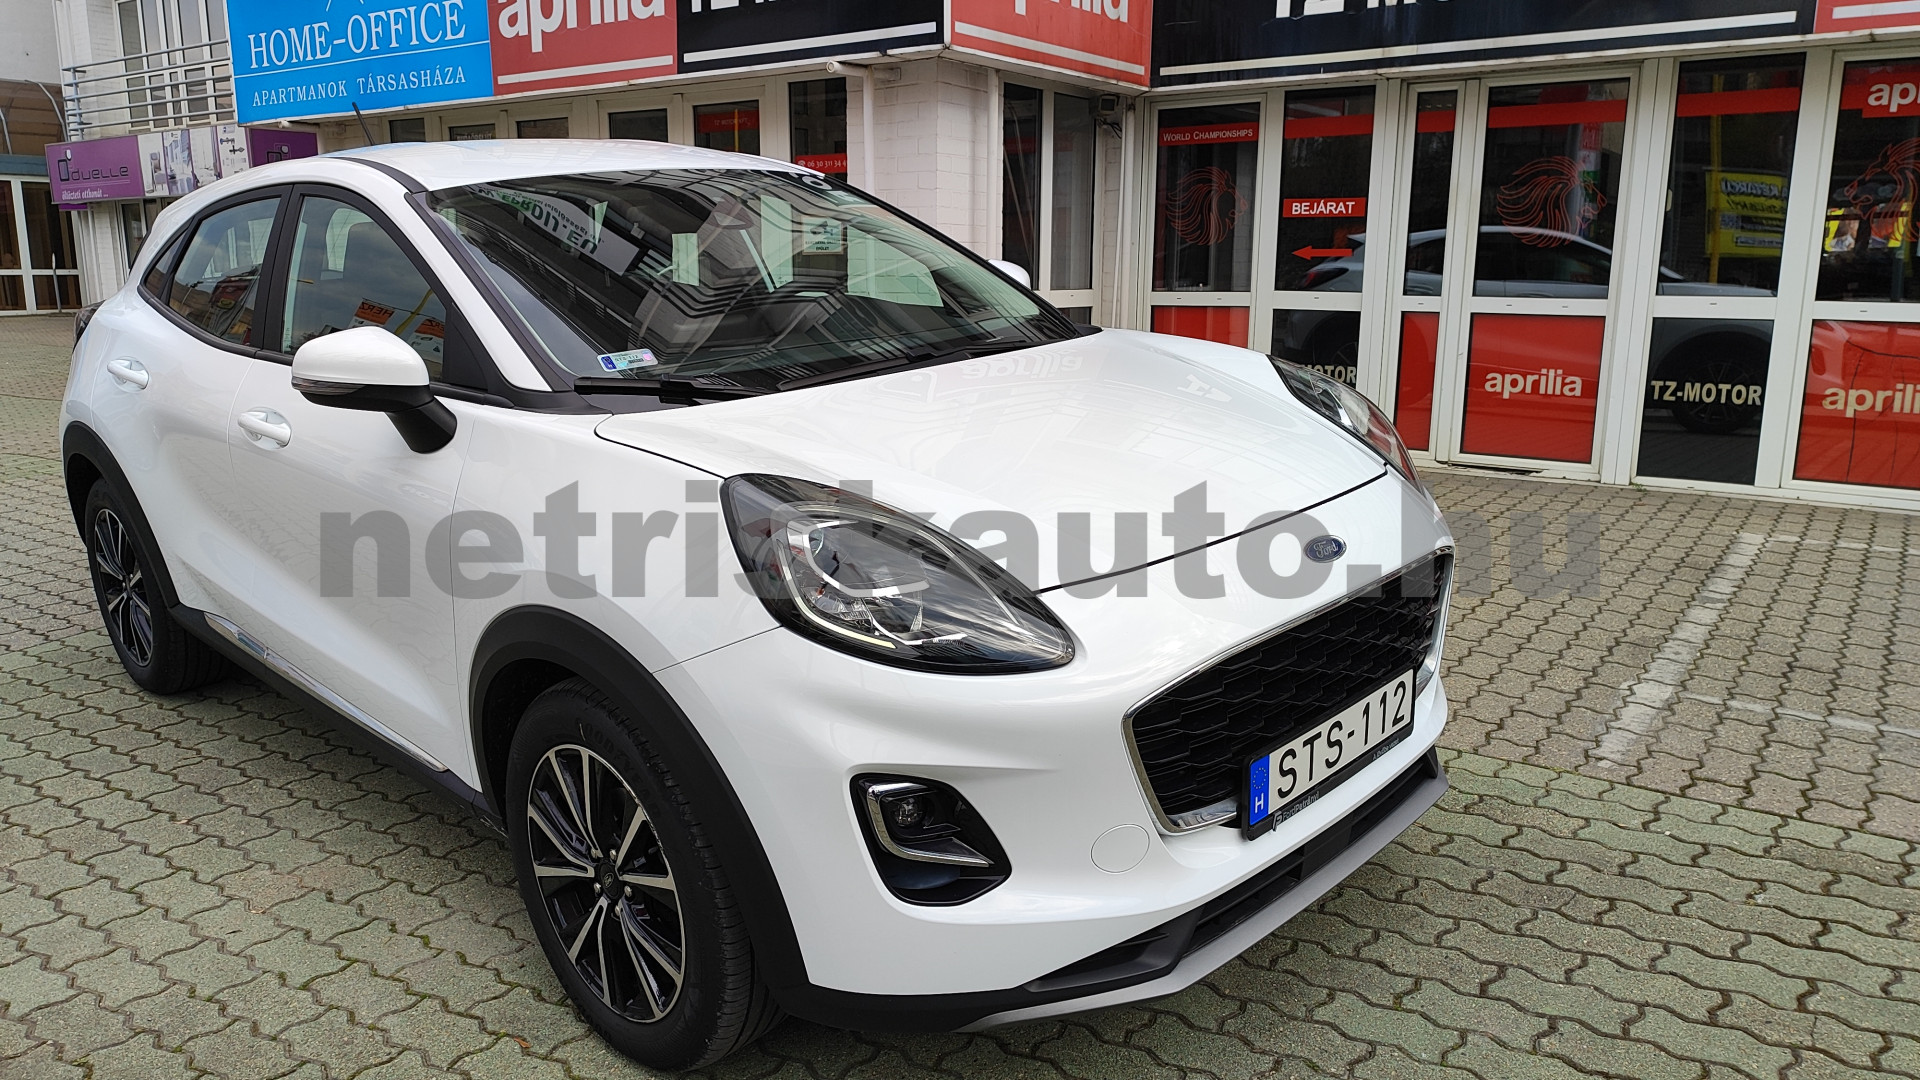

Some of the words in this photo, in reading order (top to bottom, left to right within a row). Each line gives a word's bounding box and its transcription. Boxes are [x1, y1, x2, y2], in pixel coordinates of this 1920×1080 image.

[248, 0, 466, 69] HOME-OFFICE
[252, 74, 348, 107] APARTMANOK
[356, 64, 467, 95] TÁRSASHÁZA
[1867, 82, 1920, 113] ap
[1291, 198, 1356, 216] BEJÁRAT
[1484, 368, 1583, 398] aprilia
[1650, 379, 1762, 407] TZ-MOTOR
[1314, 540, 1338, 560] Ford
[1277, 679, 1408, 802] STS-112
[1254, 795, 1265, 813] H
